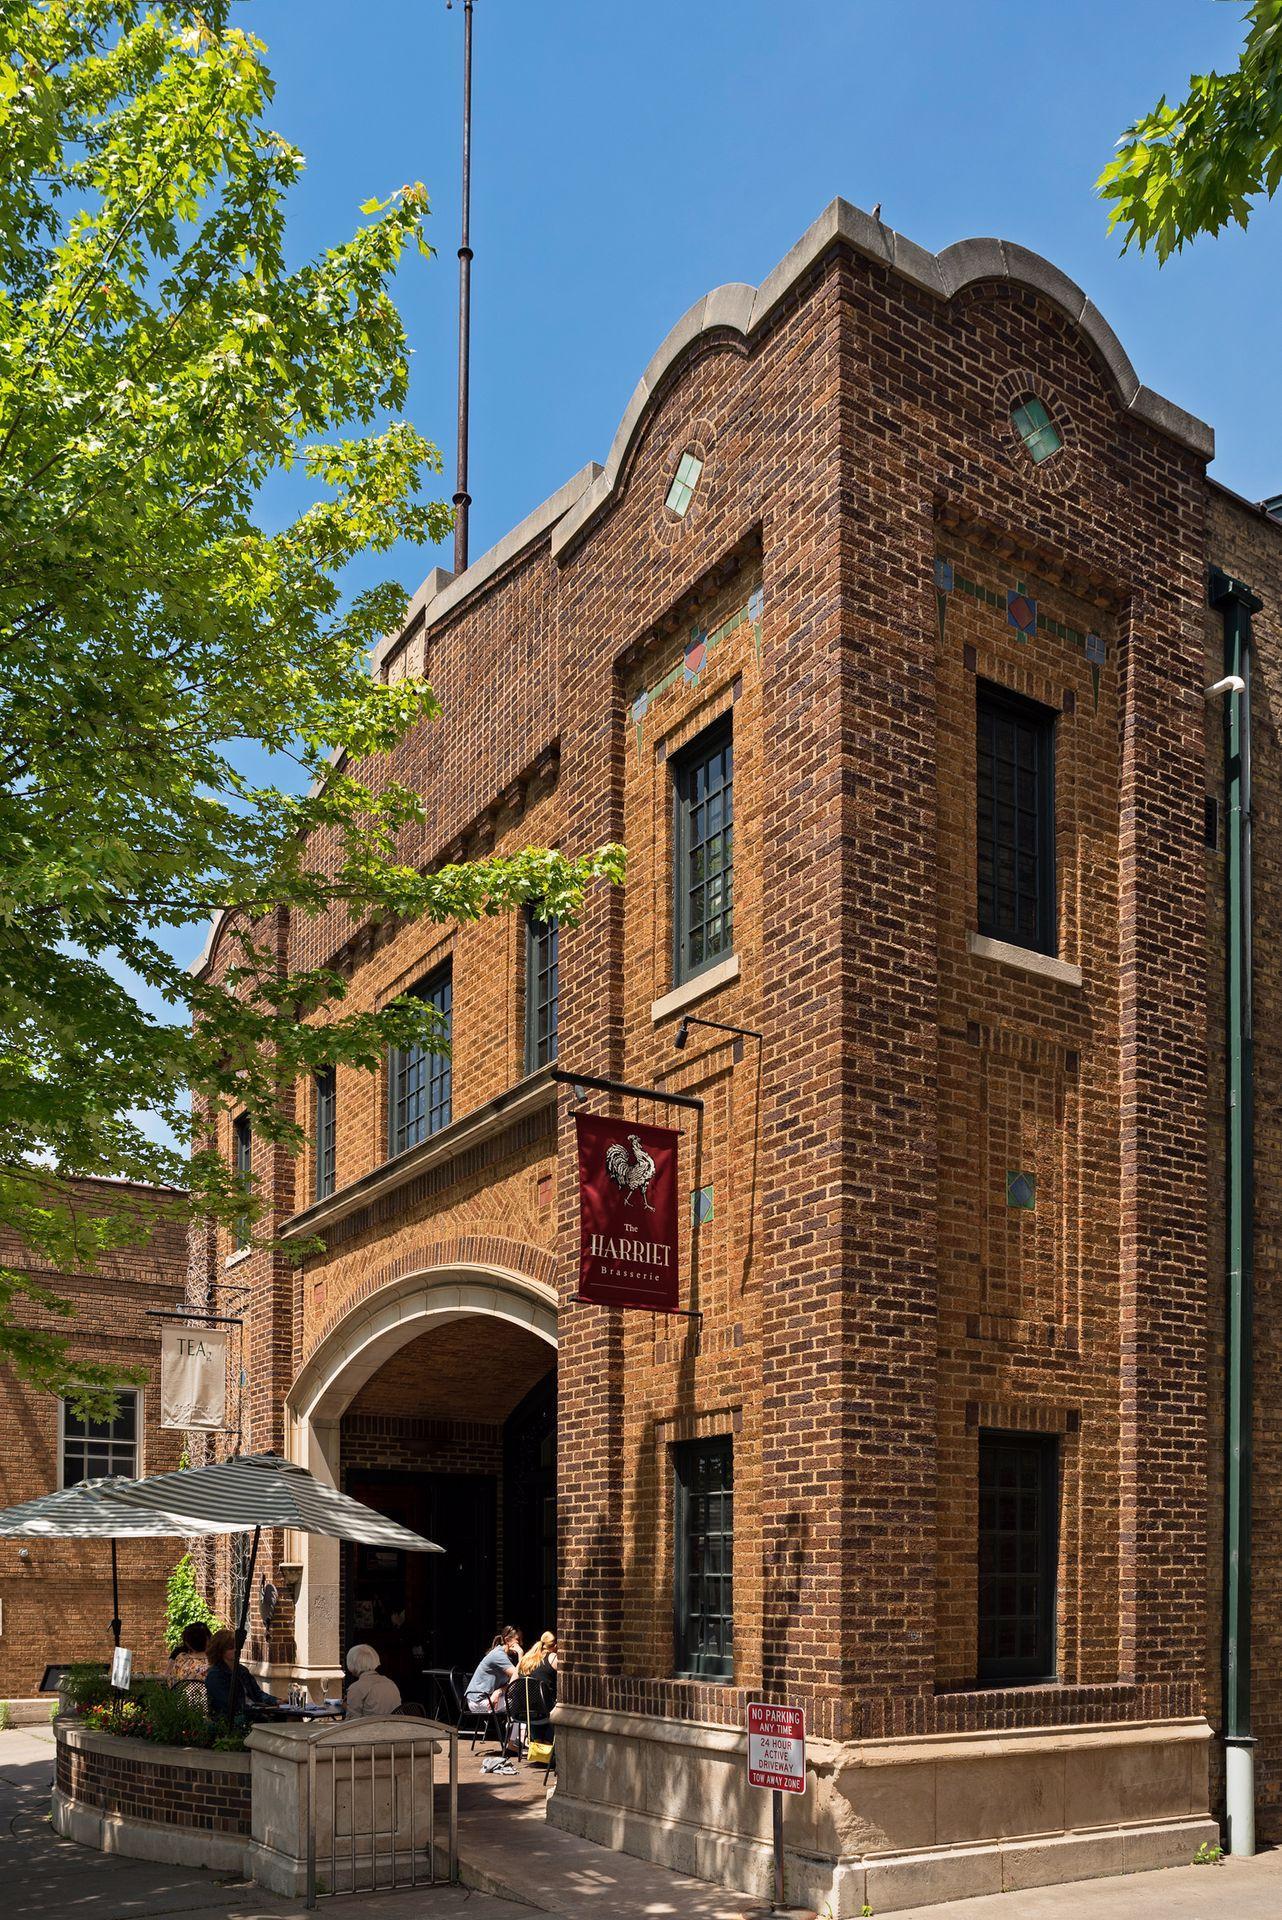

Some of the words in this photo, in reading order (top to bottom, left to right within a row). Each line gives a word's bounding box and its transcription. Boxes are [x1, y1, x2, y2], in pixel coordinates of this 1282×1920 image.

[624, 1223, 638, 1233] The
[590, 1234, 671, 1267] HARRIET
[601, 1266, 660, 1281] Brasserie
[752, 1708, 763, 1720] NO
[766, 1709, 800, 1725] PARKING
[760, 1722, 775, 1733] ANY
[777, 1724, 793, 1735] TIME
[760, 1738, 770, 1747] 24
[772, 1739, 792, 1750] HOUR
[764, 1750, 788, 1761] ACTIVE
[758, 1760, 794, 1773] DRIVEWAY
[753, 1772, 766, 1783] TOW
[766, 1775, 783, 1787] AWAY
[784, 1778, 800, 1789] ZONE
